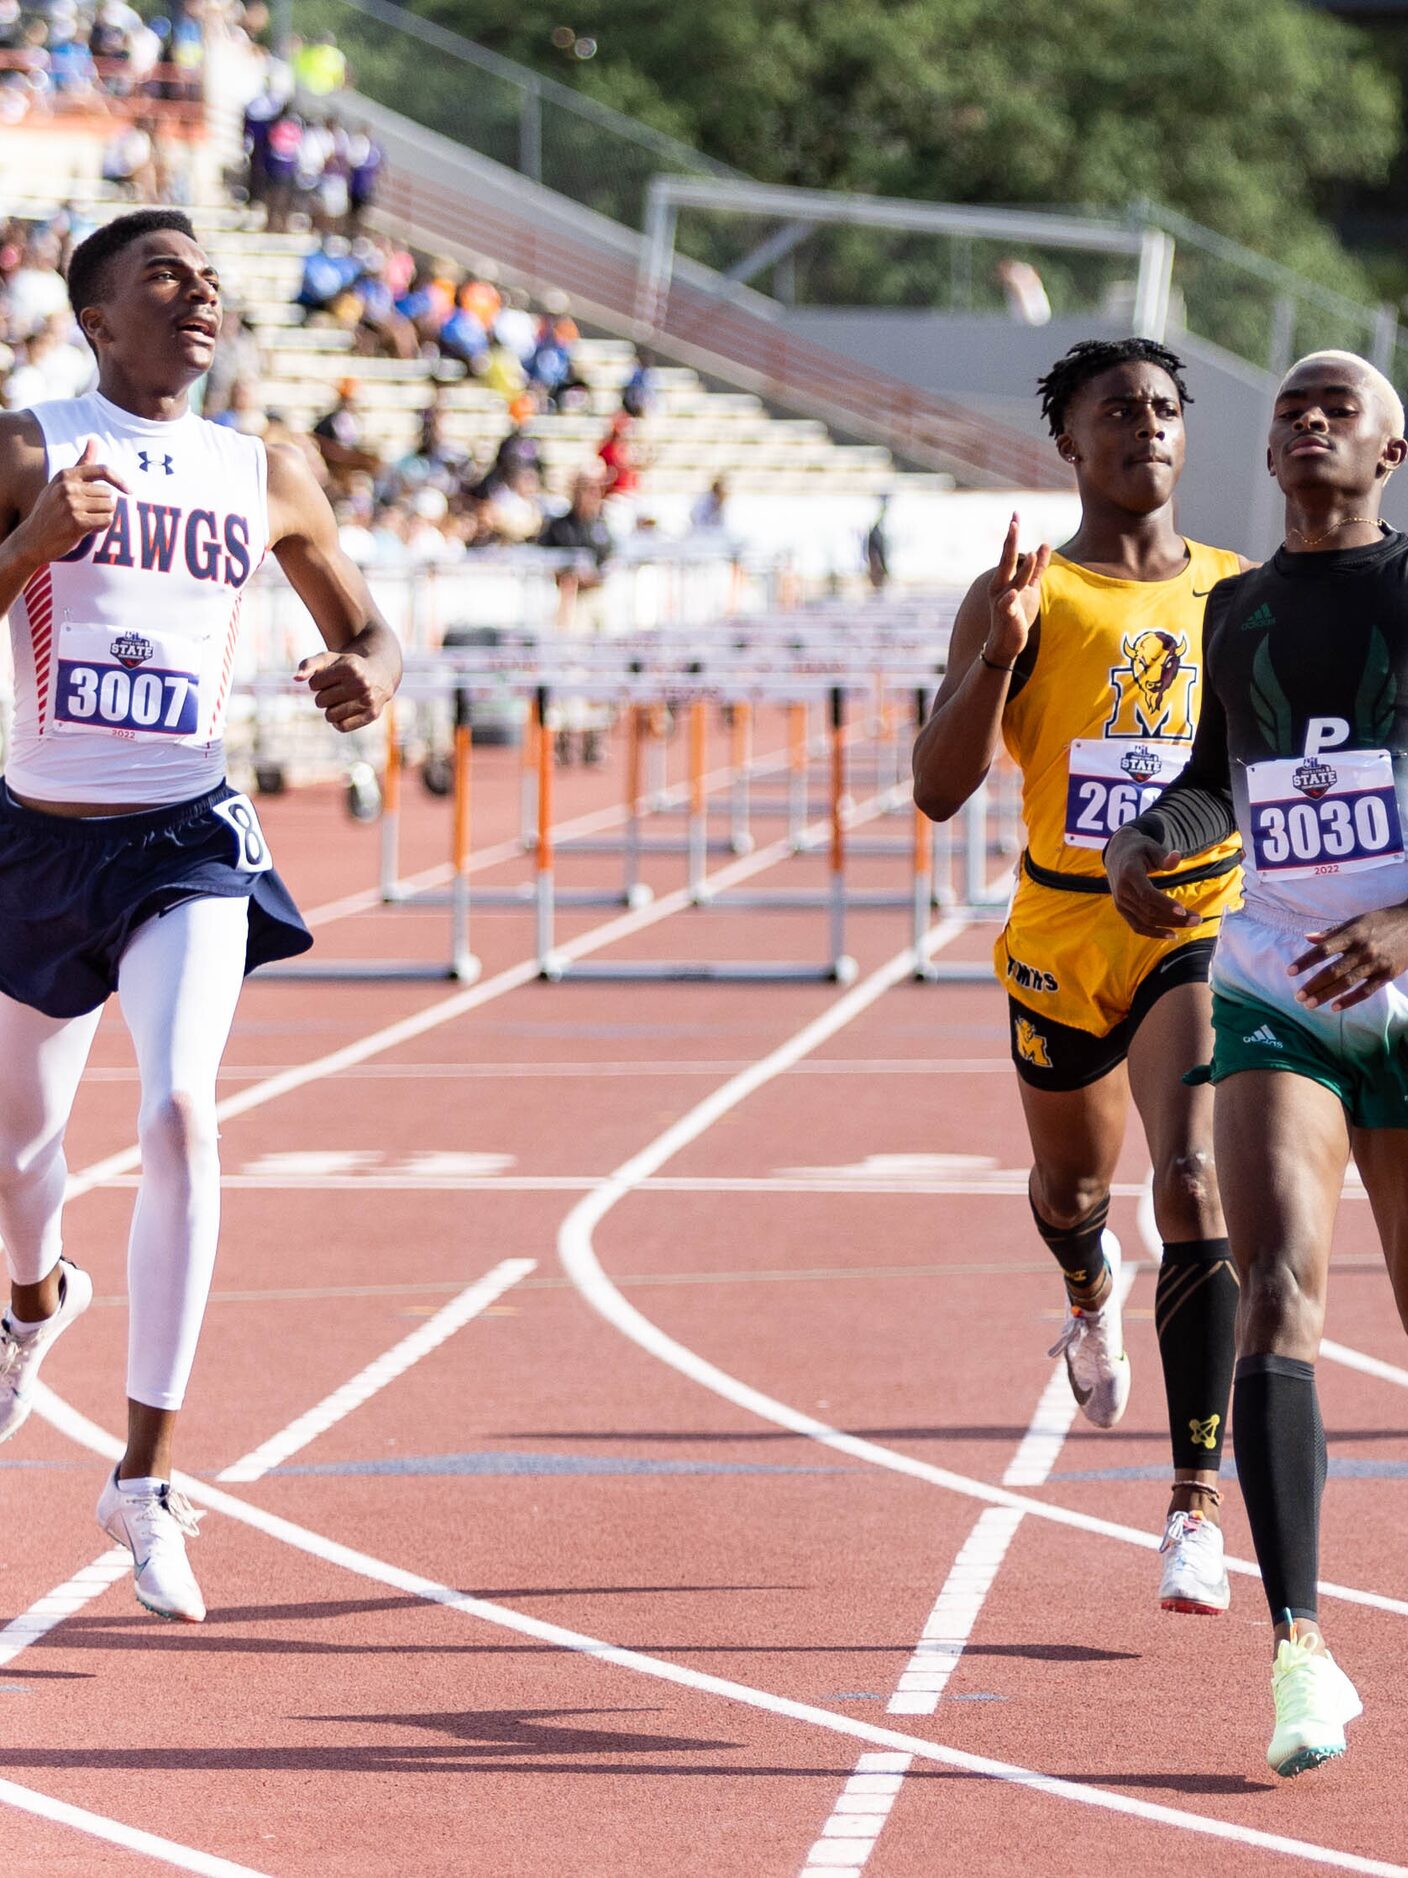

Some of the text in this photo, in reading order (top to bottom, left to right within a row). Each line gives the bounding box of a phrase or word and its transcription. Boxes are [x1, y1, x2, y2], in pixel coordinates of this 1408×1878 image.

[111, 643, 153, 657] STATE
[67, 667, 189, 727] 3007
[111, 729, 136, 739] 2022
[1303, 717, 1350, 758] P
[1121, 758, 1162, 772] STATE
[1293, 771, 1337, 787] STATE
[228, 803, 264, 866] 8
[1260, 796, 1390, 862] 3030
[1314, 865, 1340, 875] 2022
